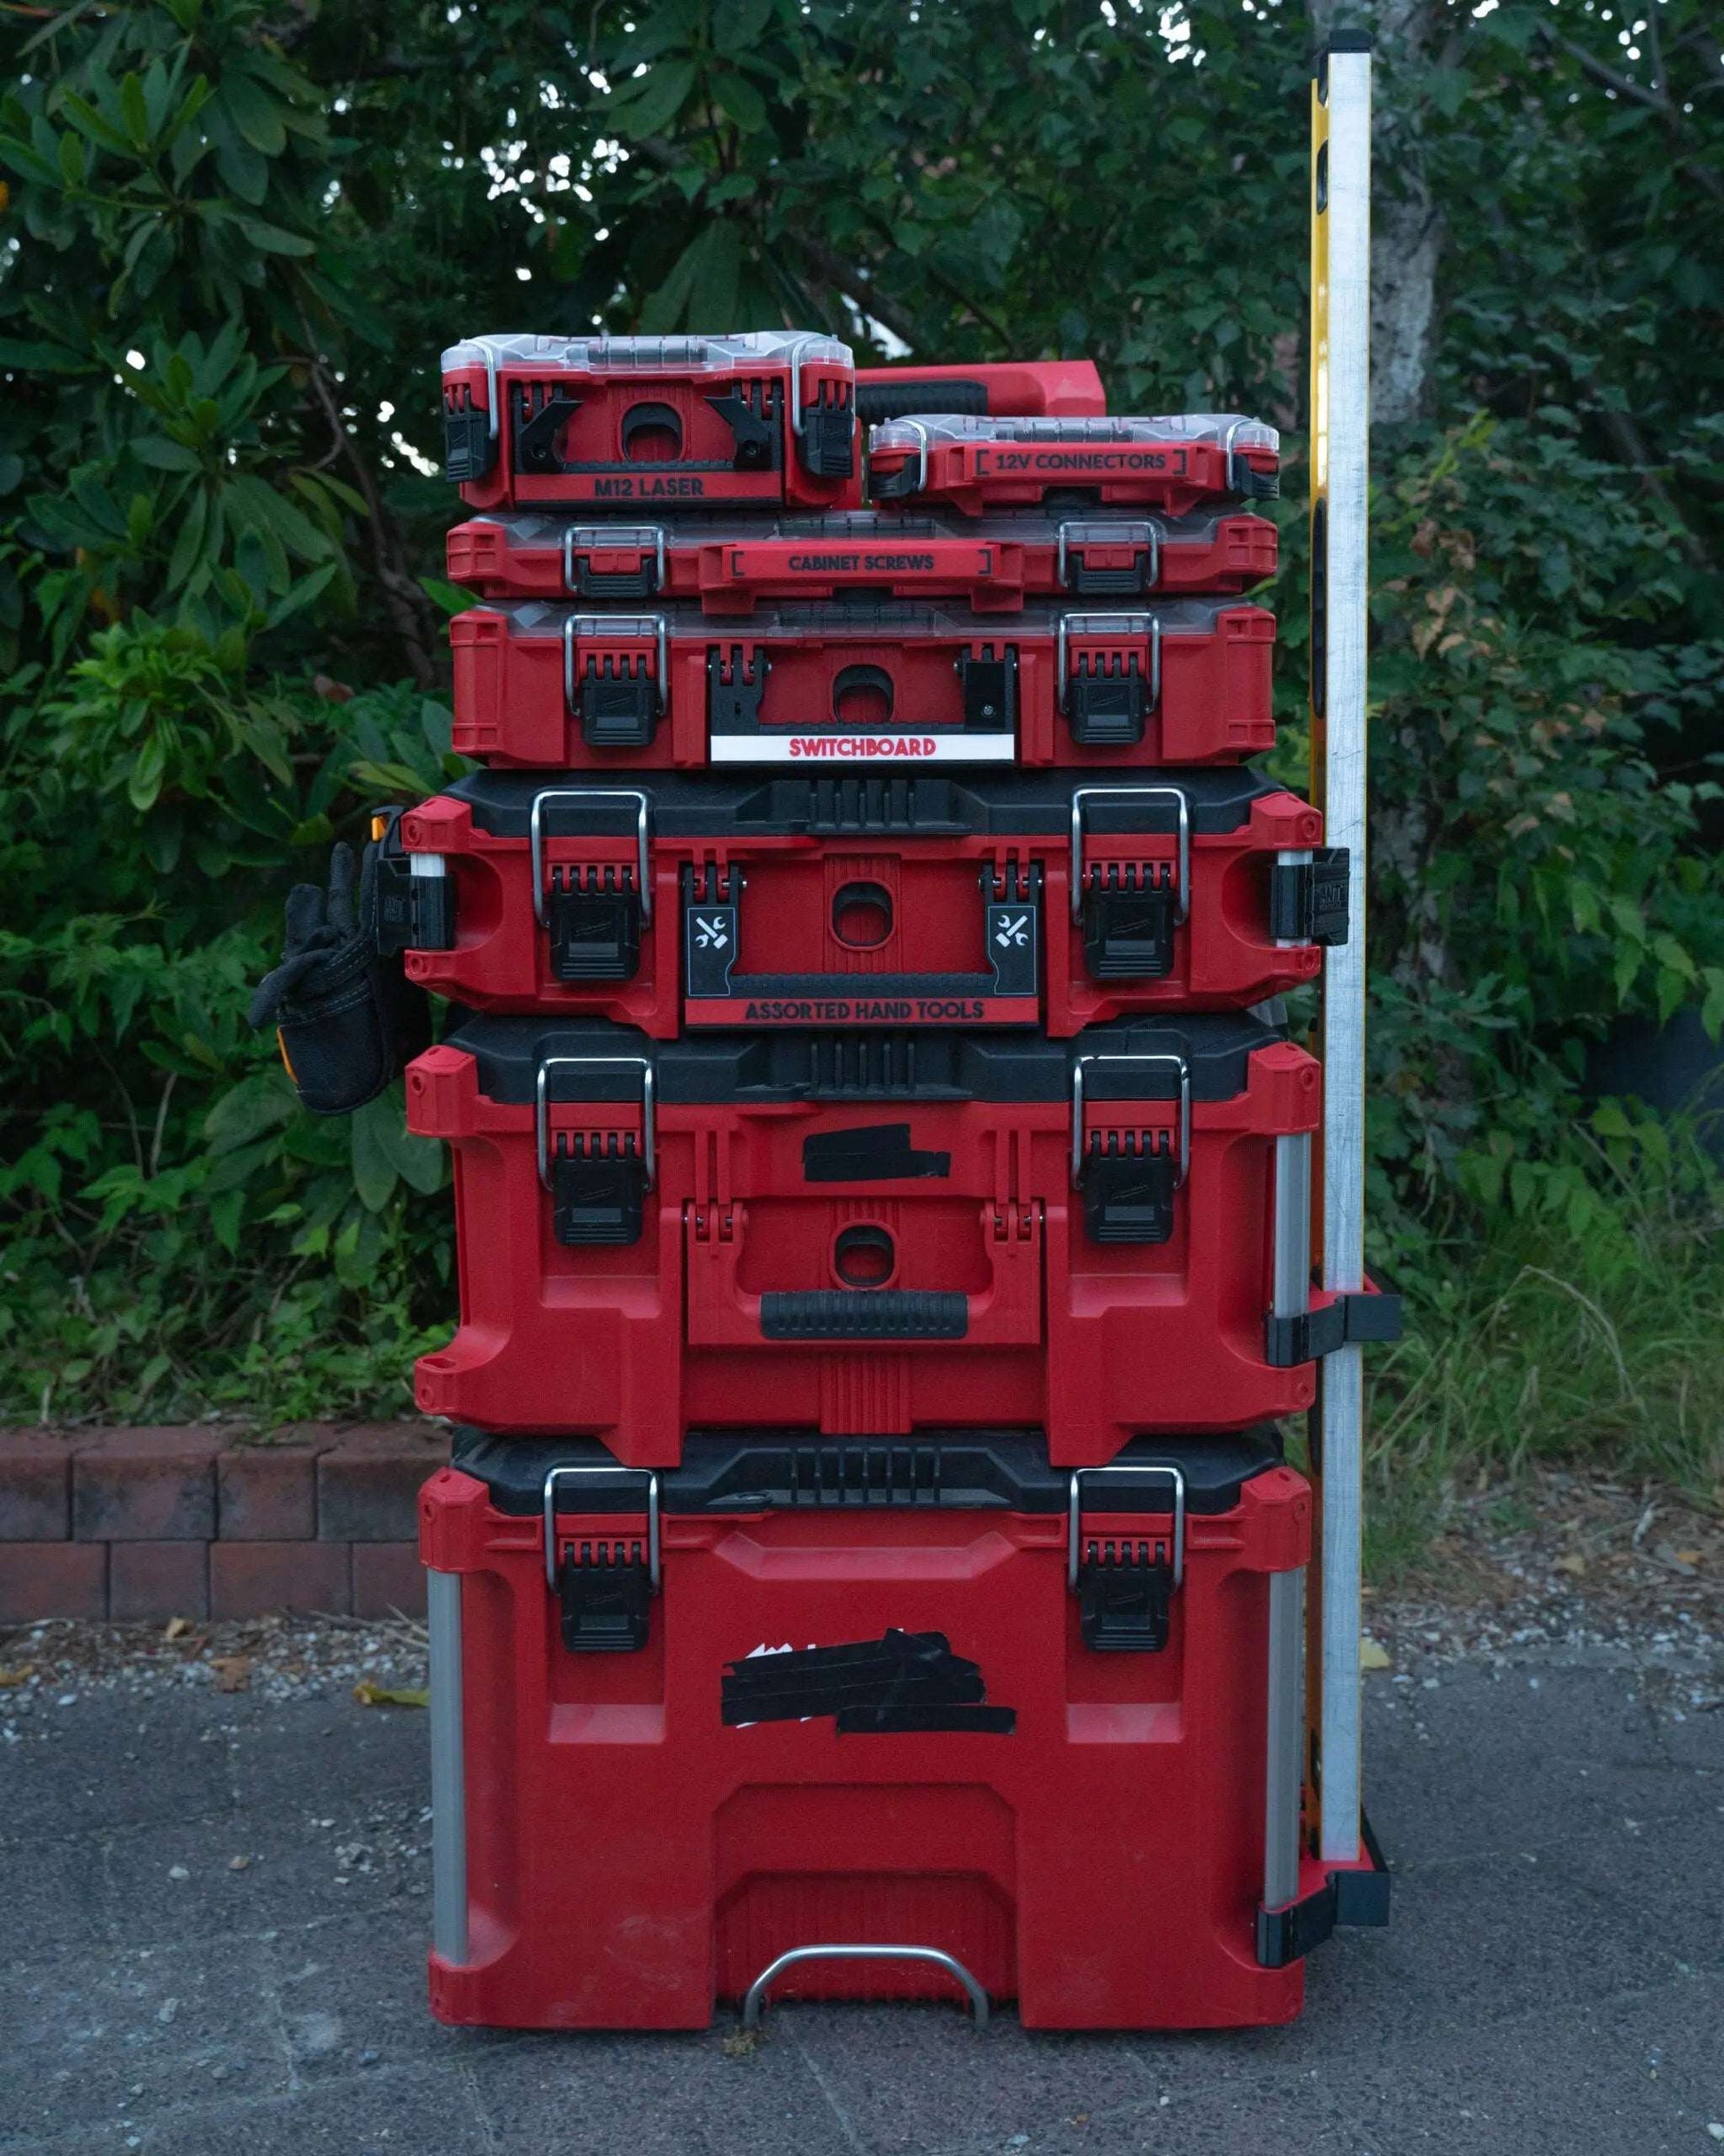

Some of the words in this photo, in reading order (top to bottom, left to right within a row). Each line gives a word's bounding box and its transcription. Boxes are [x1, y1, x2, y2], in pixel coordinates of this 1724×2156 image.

[996, 454, 1030, 470] 12V
[1035, 454, 1166, 470] CONNECTORS
[594, 479, 633, 496] M12
[639, 479, 703, 496] LASER
[788, 555, 860, 572] CABINET
[864, 555, 935, 571] SCREWS
[789, 738, 936, 757] SWITCHBOARD
[745, 1002, 850, 1020] ASSORTED
[855, 1001, 912, 1019] HAND
[917, 1001, 984, 1019] TOOLS
